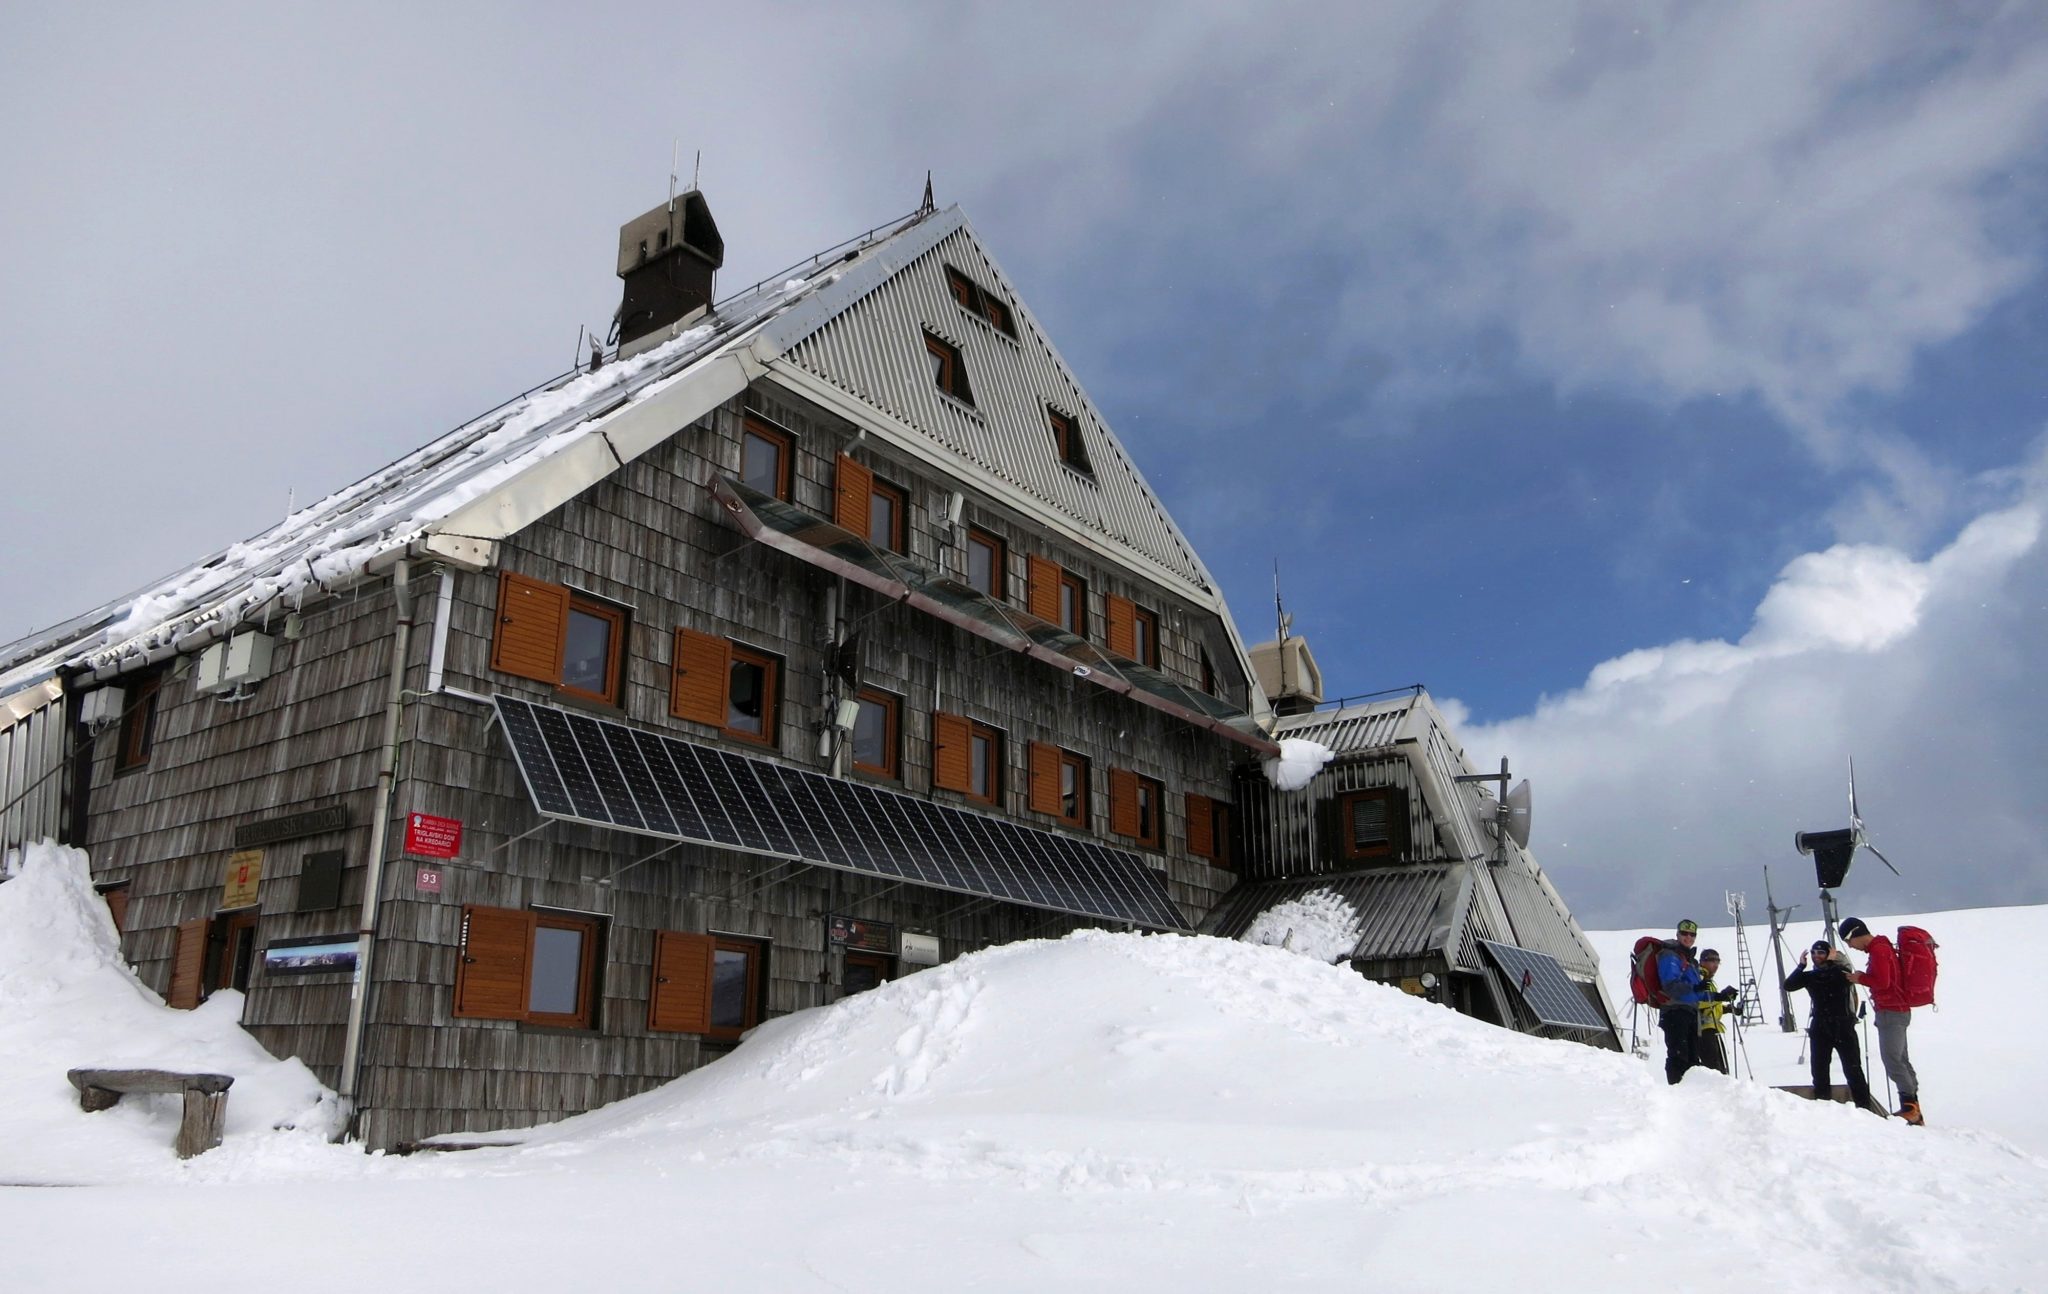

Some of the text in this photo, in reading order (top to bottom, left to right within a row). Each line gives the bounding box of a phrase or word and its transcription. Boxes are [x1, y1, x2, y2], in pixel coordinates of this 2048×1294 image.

[314, 807, 343, 826] DOM
[414, 829, 443, 839] TRIGLAVSKI
[425, 838, 451, 847] KREDARICI
[422, 873, 436, 884] 93
